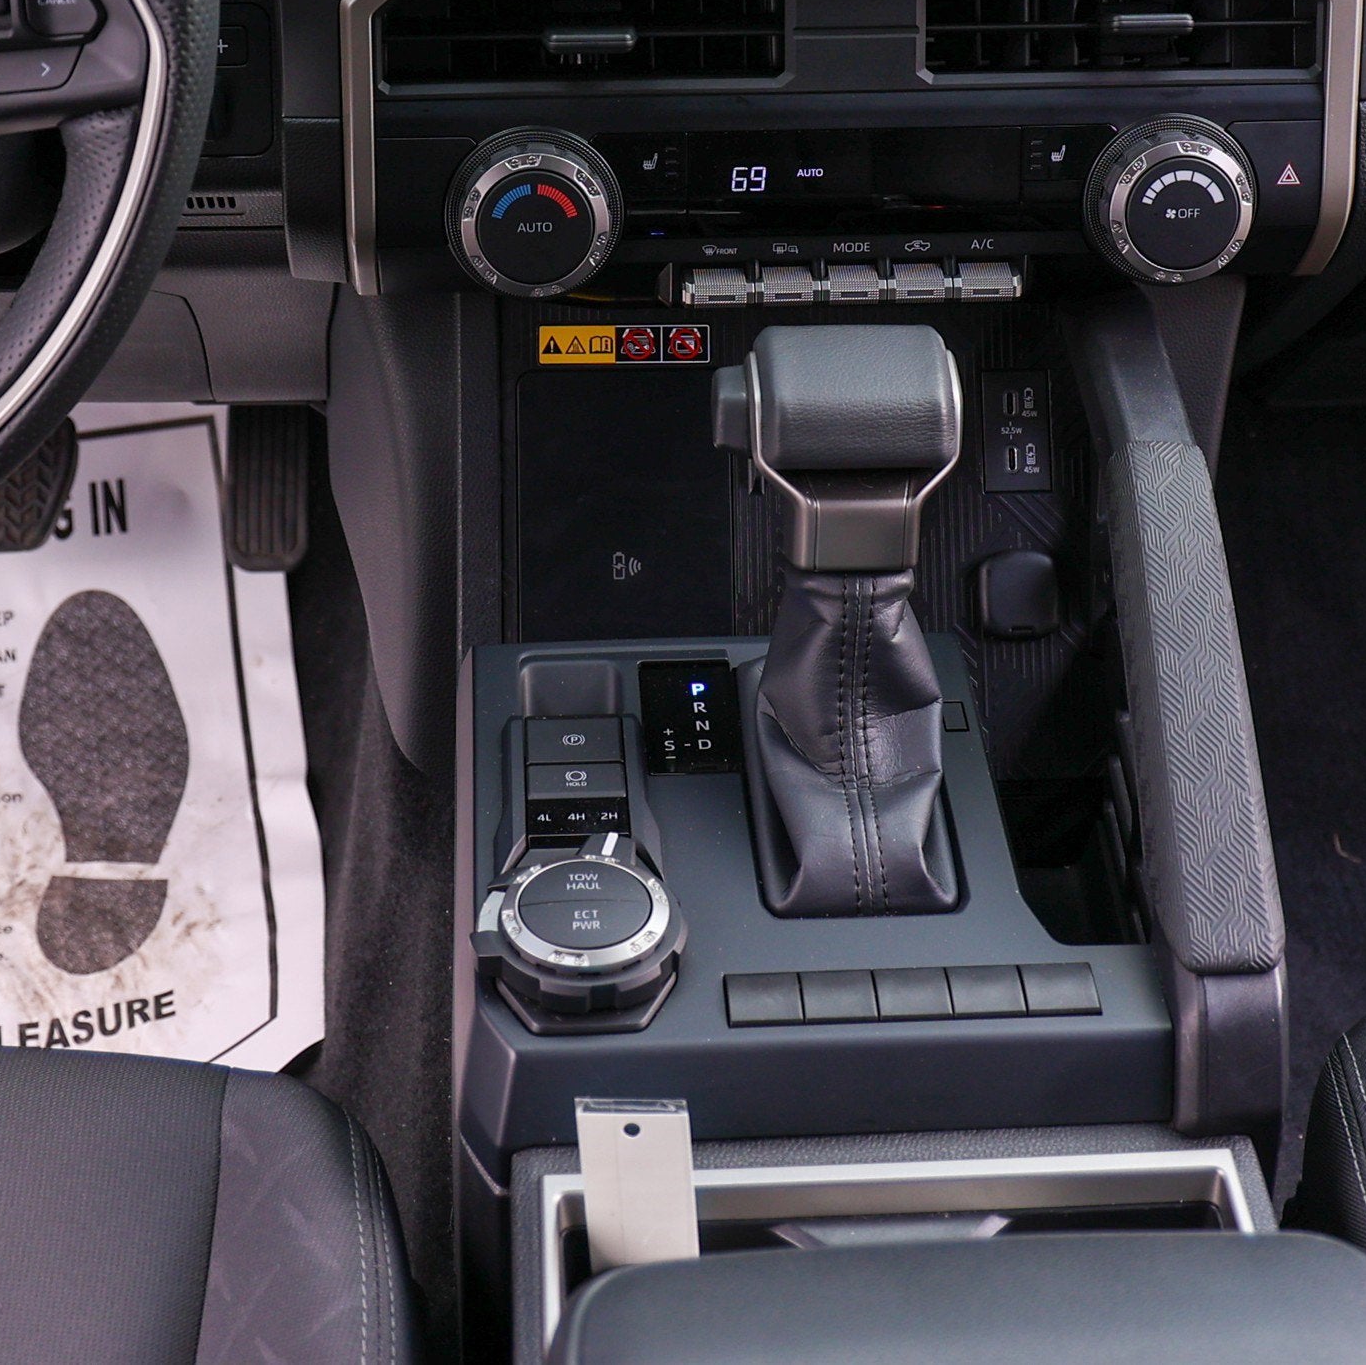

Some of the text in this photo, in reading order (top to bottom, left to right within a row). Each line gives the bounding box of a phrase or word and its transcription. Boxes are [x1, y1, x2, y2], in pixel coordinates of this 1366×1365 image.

[796, 168, 823, 177] AUTO
[731, 166, 766, 192] 69
[1178, 208, 1200, 219] OFF
[517, 222, 553, 233] AUTO
[833, 242, 870, 253] MODE
[971, 239, 994, 250] A/C
[716, 247, 738, 255] FRONT
[1024, 466, 1040, 474] 45W
[90, 478, 127, 536] IN
[691, 683, 705, 695] P
[693, 701, 707, 713] R
[695, 720, 710, 731] N
[664, 739, 712, 751] S D
[537, 813, 552, 822] 4L
[567, 813, 586, 821] 4H
[600, 812, 618, 820] 2H
[568, 873, 599, 881] TOW
[574, 910, 599, 919] ECT
[572, 921, 601, 930] PWR
